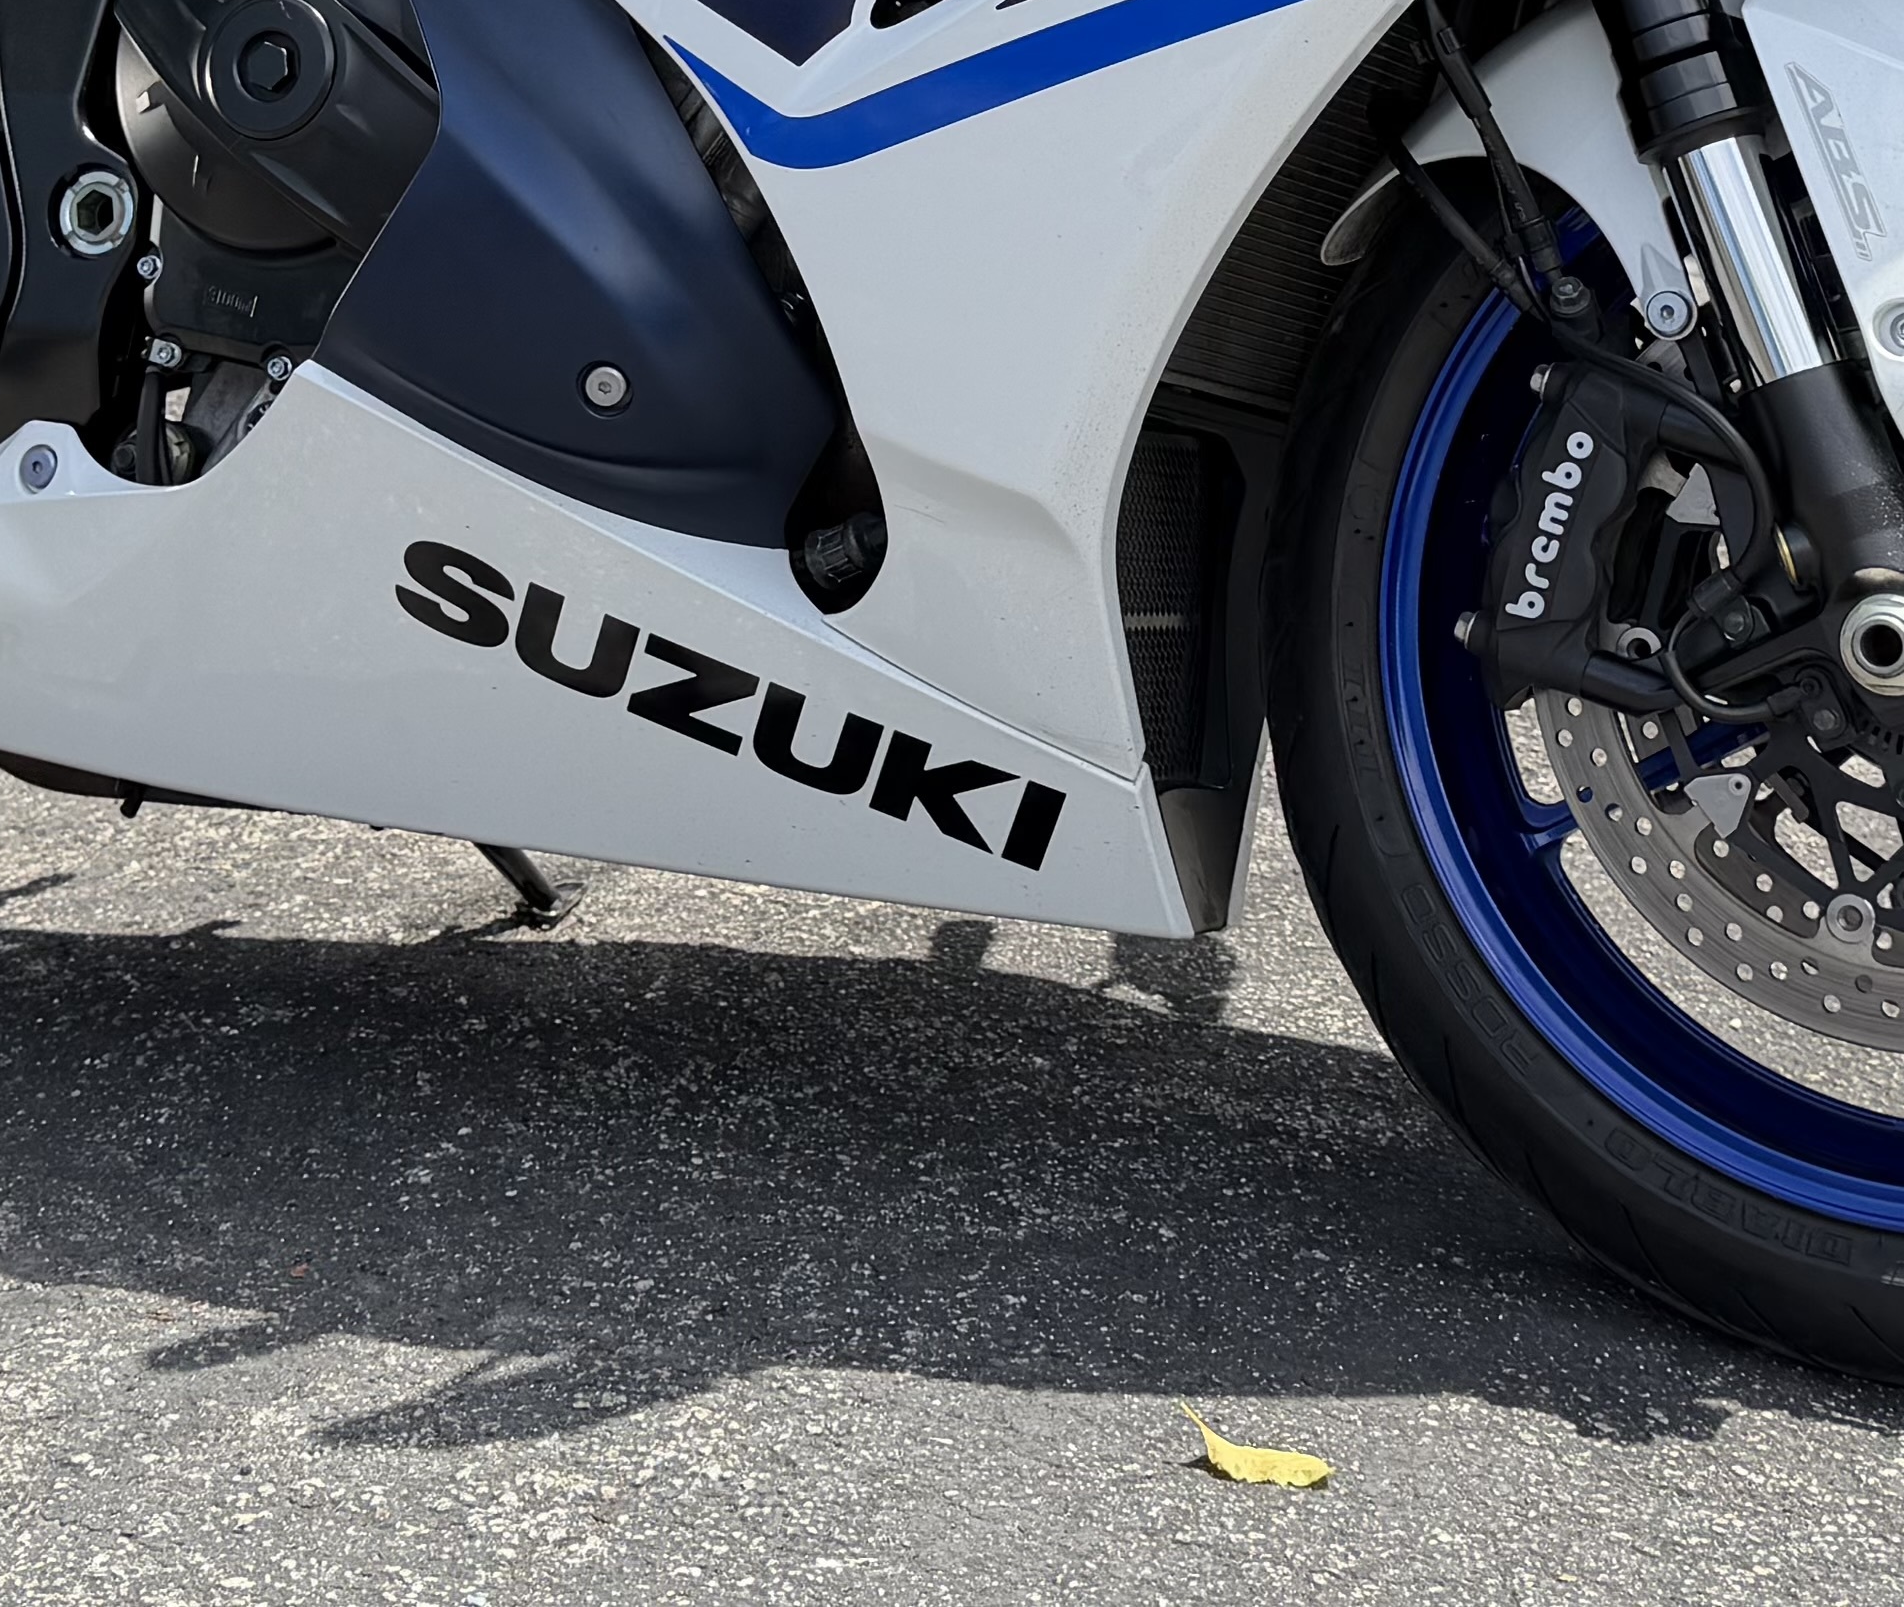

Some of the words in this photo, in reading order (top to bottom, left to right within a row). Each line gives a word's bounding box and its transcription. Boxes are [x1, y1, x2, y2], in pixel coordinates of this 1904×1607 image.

[1786, 61, 1887, 242] ABS
[1505, 431, 1594, 619] brembo
[395, 540, 1067, 872] SUZUKI
